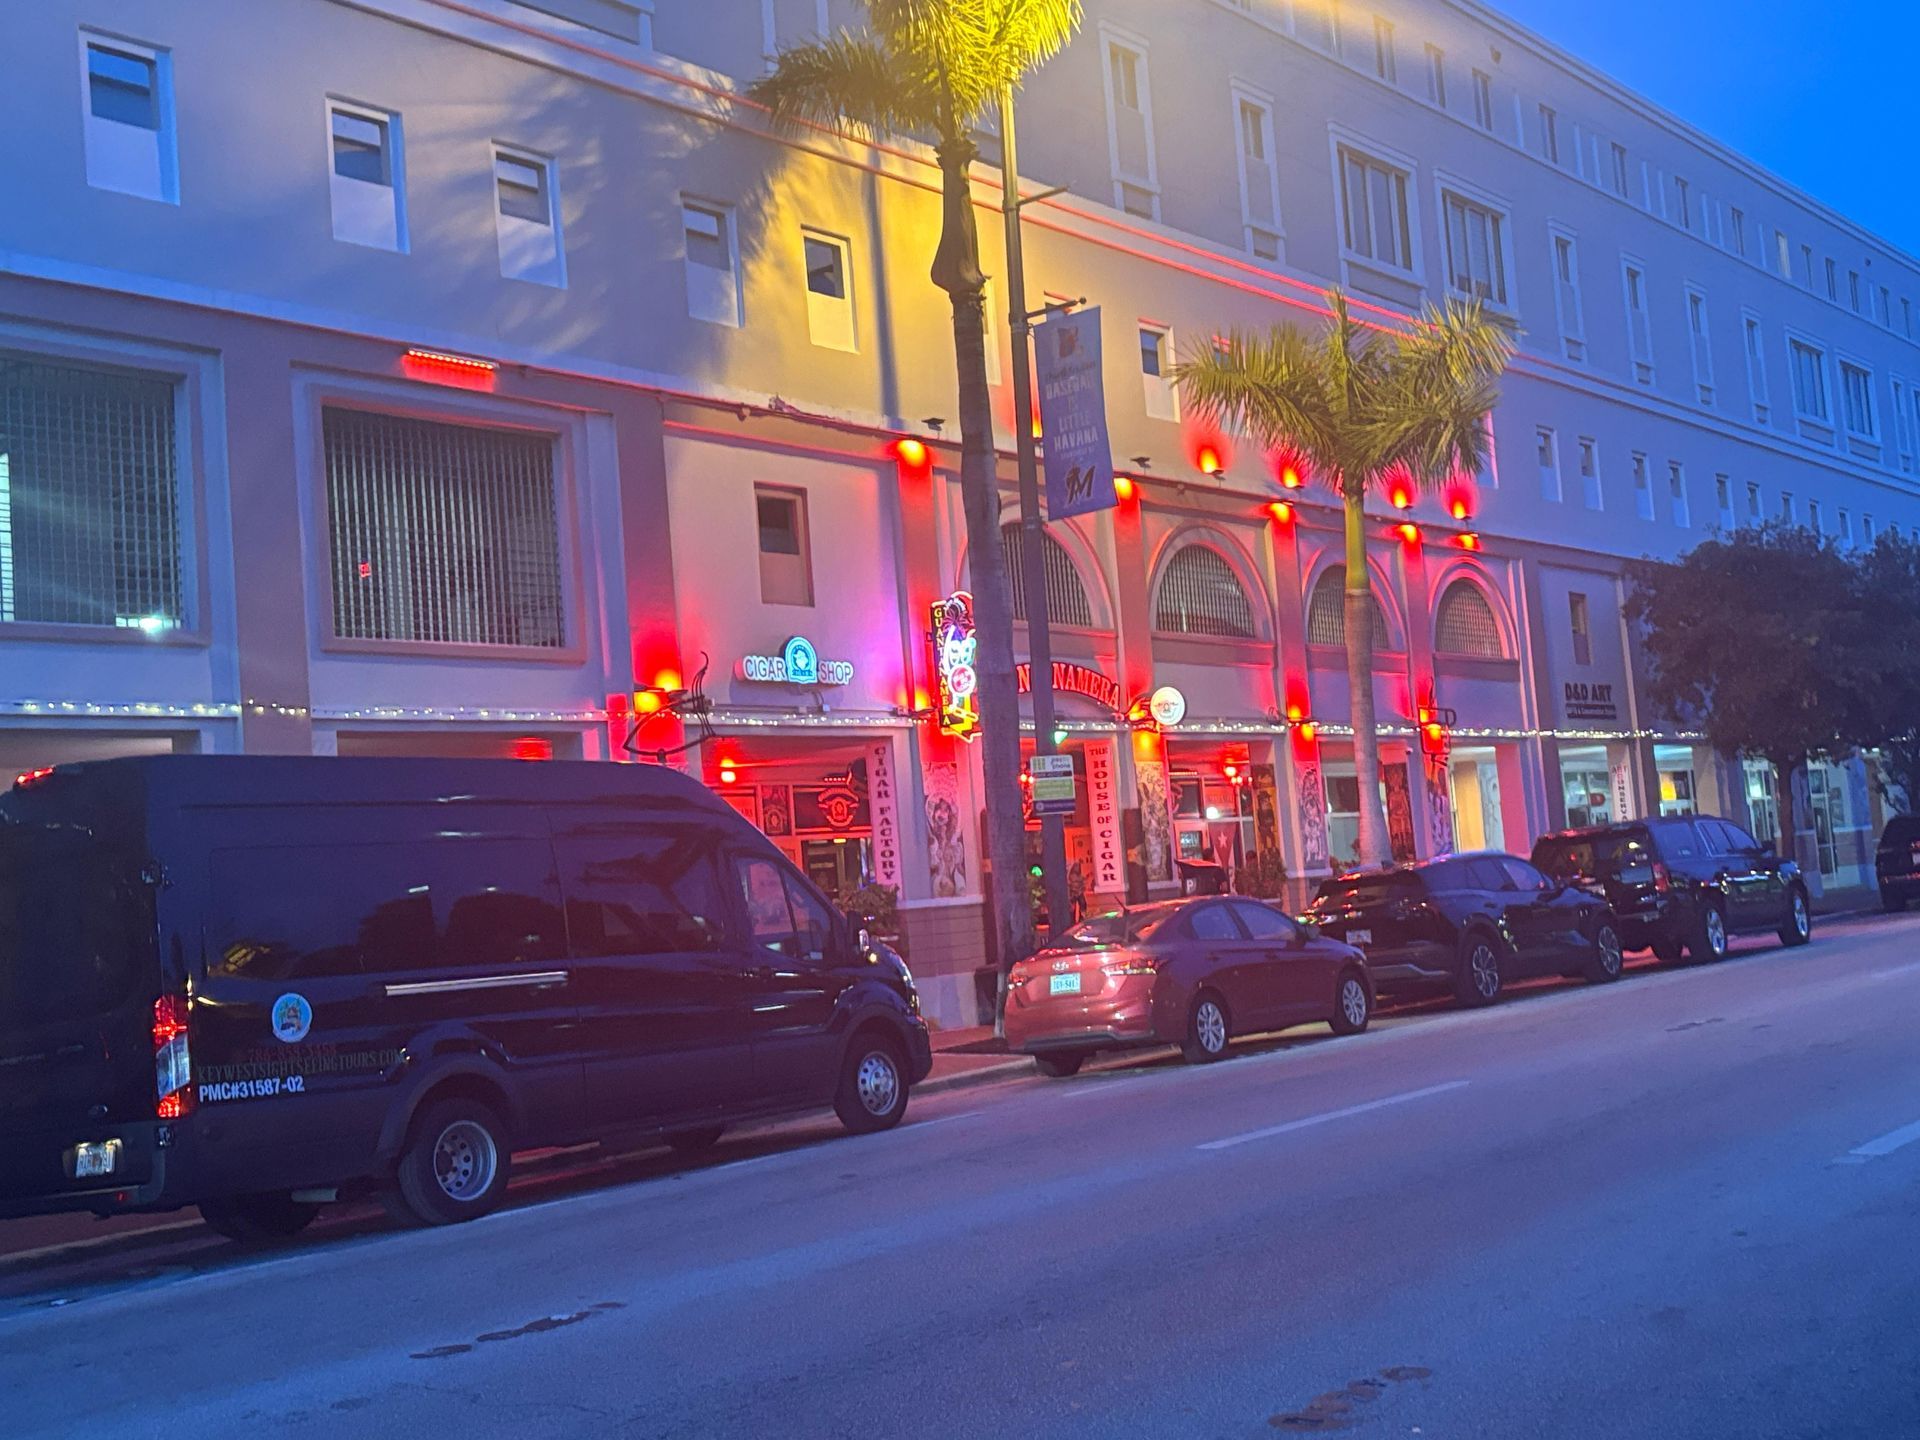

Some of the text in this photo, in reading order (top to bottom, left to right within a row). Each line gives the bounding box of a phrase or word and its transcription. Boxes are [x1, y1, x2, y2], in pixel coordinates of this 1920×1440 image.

[1058, 410, 1091, 434] LITTLE
[1054, 426, 1099, 452] HAVANA
[743, 657, 853, 684] CIGAR SHOP
[1565, 683, 1612, 702] D&D ART
[1089, 747, 1108, 757] THE
[1093, 759, 1111, 812] HOUSE
[874, 746, 896, 880] CIGAR FACTORY
[1097, 815, 1112, 825] OF
[1099, 829, 1117, 882] CIGAR
[199, 1075, 305, 1103] PMC#31587-02
